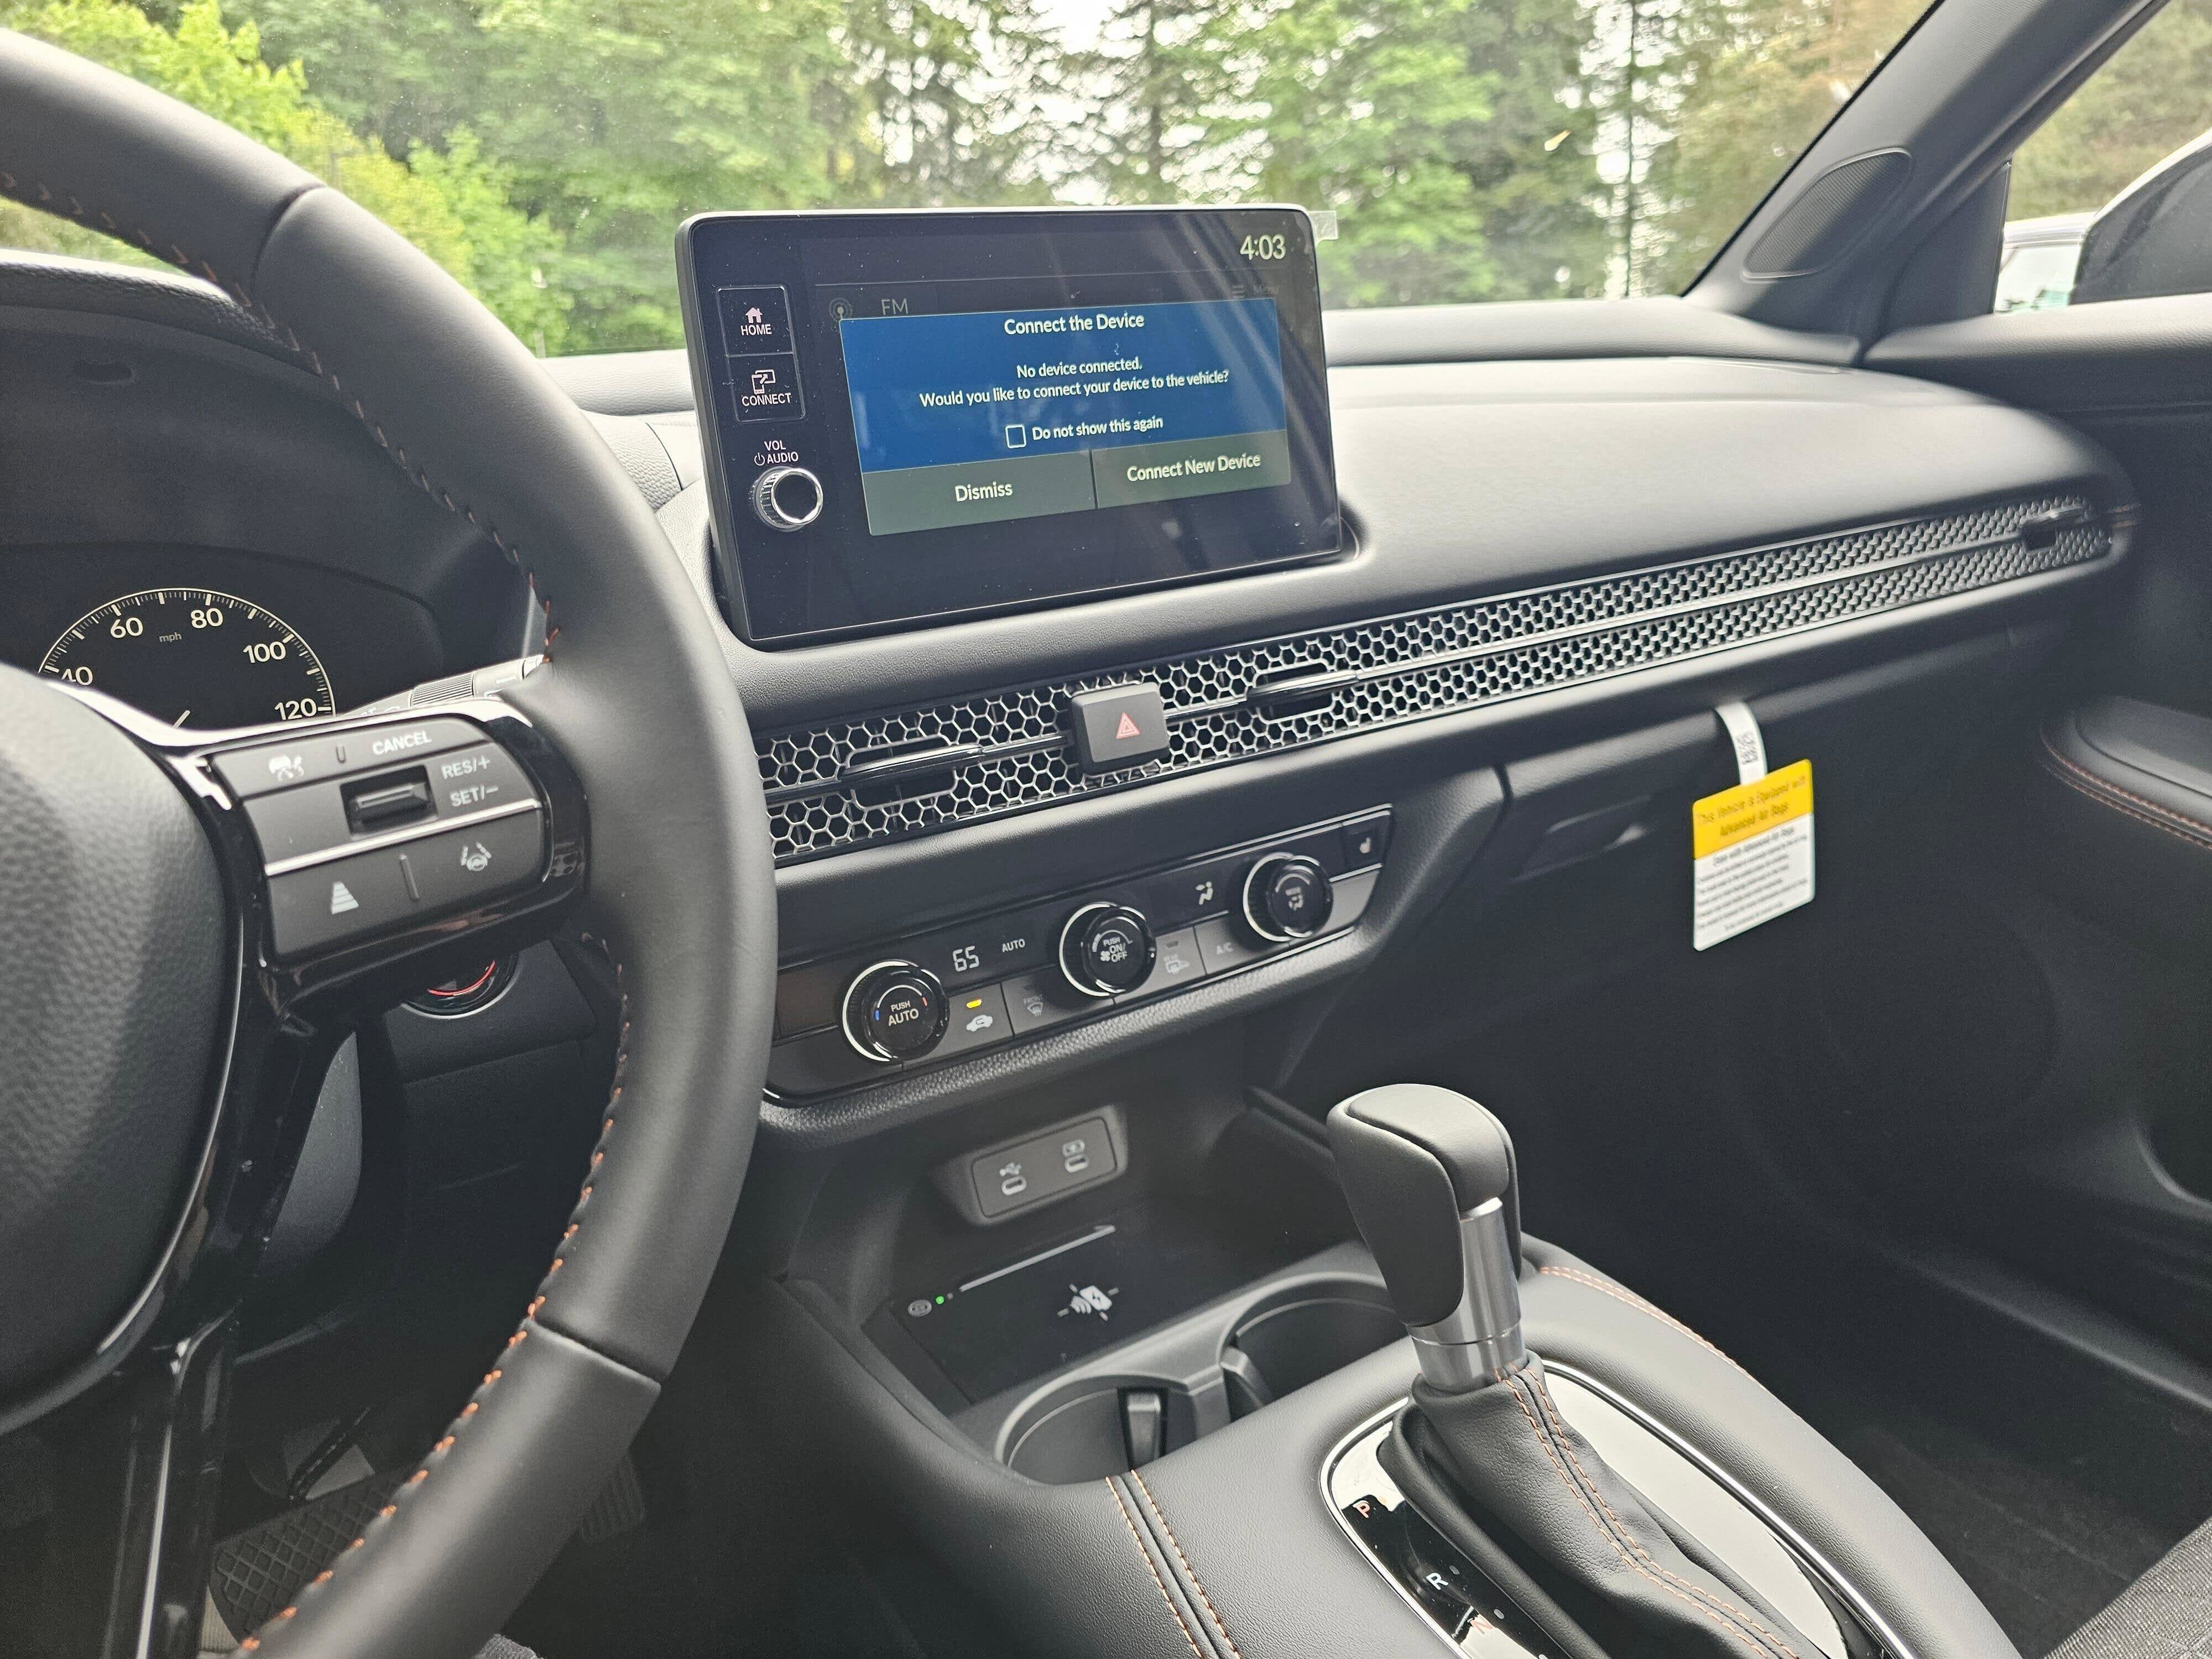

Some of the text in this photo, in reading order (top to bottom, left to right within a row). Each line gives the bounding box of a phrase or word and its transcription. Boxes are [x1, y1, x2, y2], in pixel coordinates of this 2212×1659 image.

[1240, 234, 1286, 260] 4:03
[881, 299, 908, 315] FM
[740, 323, 772, 336] HOME
[1004, 311, 1145, 335] Connect the Device
[1016, 356, 1143, 379] No device connected.
[919, 369, 1230, 407] Would you like to connect your device to the vehicle?
[741, 393, 792, 406] CONNECT
[1032, 415, 1164, 441] Do not show this again
[764, 440, 786, 451] VOL
[766, 452, 799, 463] AUDIO
[1126, 451, 1261, 482] Connect New Device
[954, 481, 1014, 502] Dismiss
[111, 617, 143, 638] 60
[190, 608, 223, 629] 80
[159, 632, 182, 643] mph
[242, 640, 286, 664] 100
[274, 697, 317, 721] 120
[372, 730, 432, 756] CANCEL
[1001, 938, 1025, 953] AUTO
[1103, 936, 1121, 947] PUSH
[1216, 942, 1234, 955] A/C
[952, 946, 980, 972] 65
[1111, 950, 1129, 963] OFF
[891, 1000, 911, 1011] PUSH
[888, 1008, 919, 1026] AUTO
[1352, 1500, 1371, 1519] P
[1426, 1572, 1448, 1590] R
